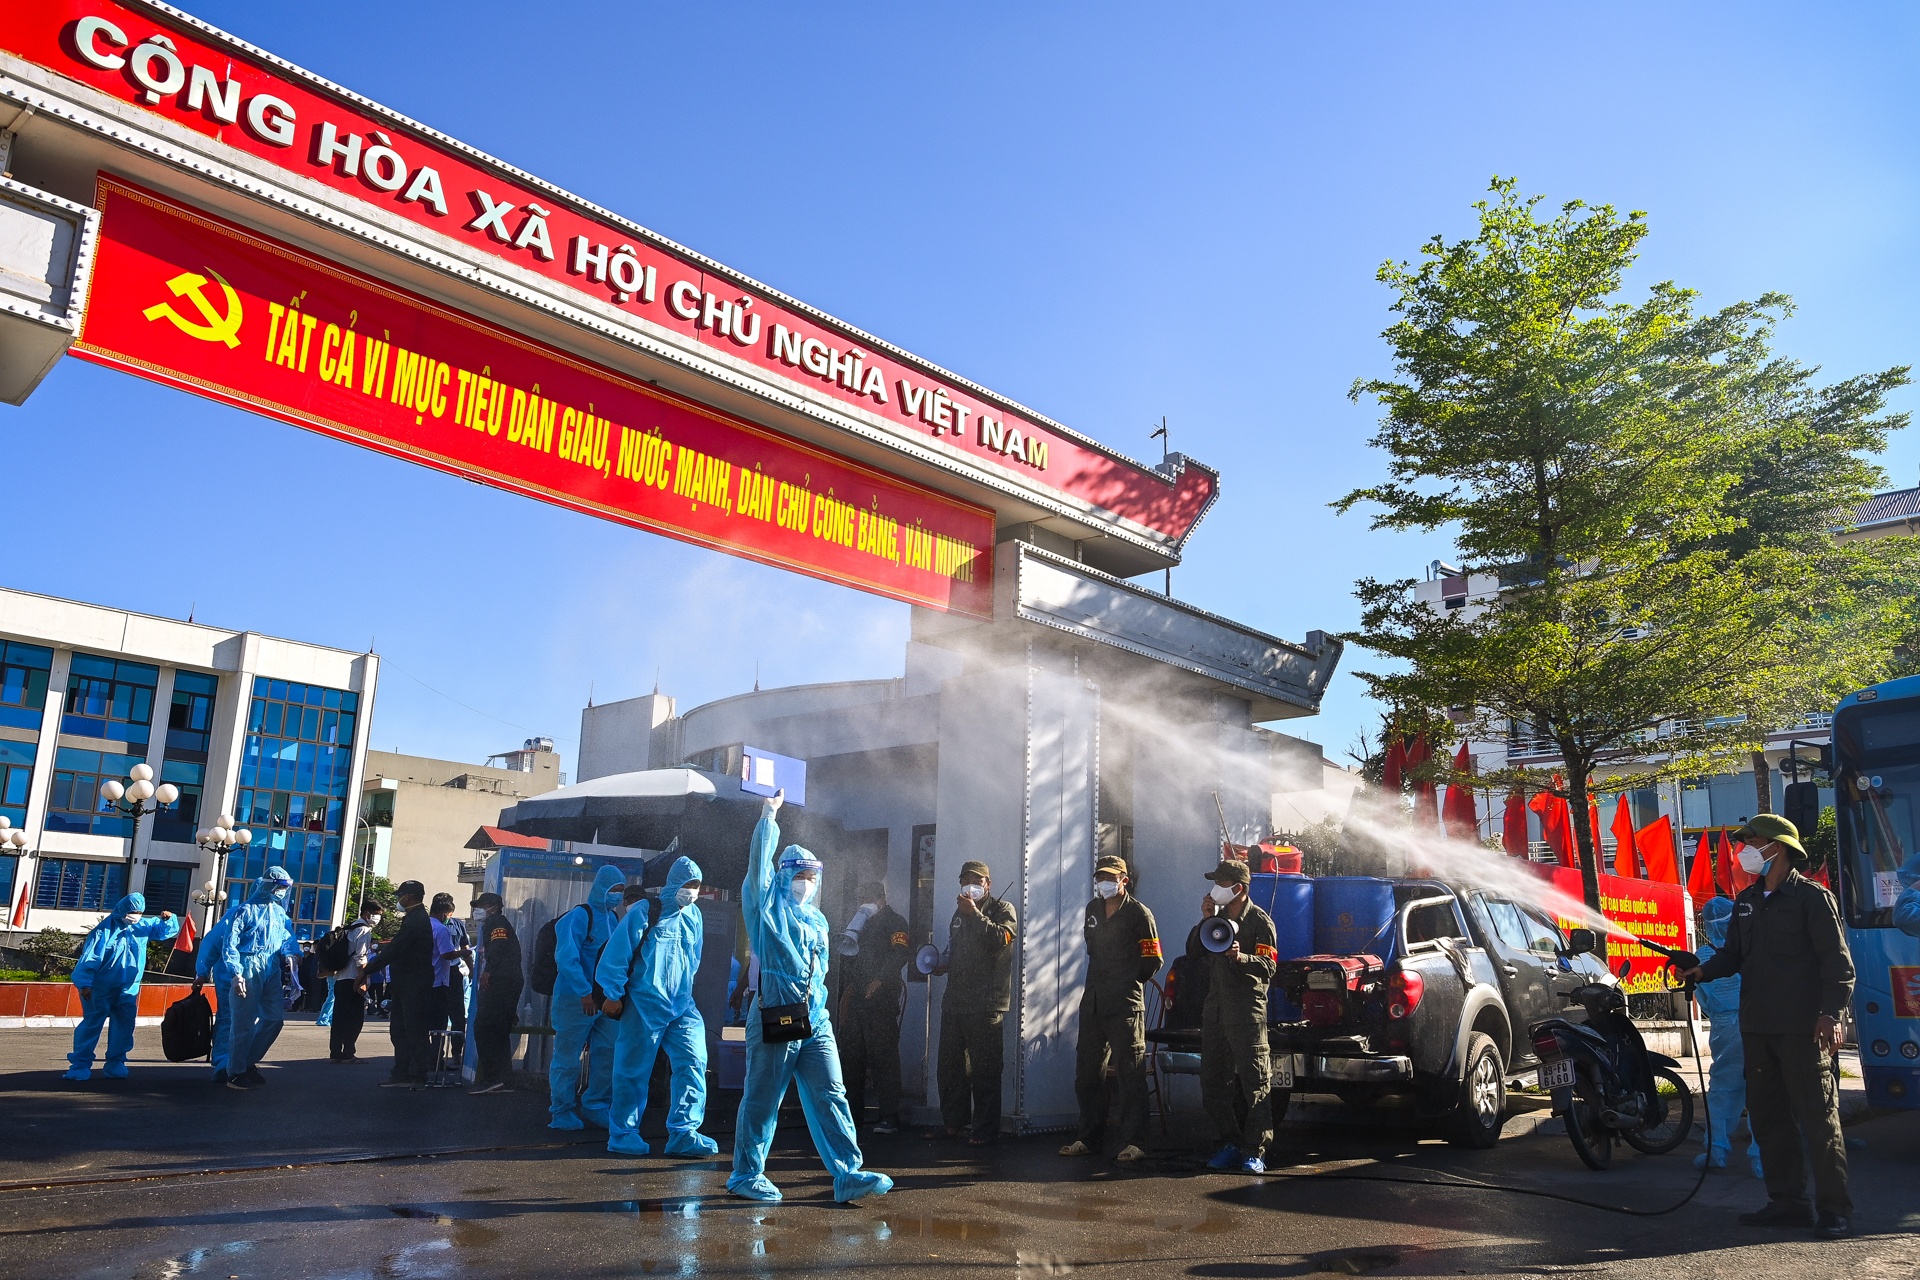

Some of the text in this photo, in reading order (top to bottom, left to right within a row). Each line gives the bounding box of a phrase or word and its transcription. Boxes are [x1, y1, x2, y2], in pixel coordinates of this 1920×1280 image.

[74, 15, 1049, 471] CỘNG HÒA XÃ HỘI CHỦ NGHĨA VIỆT NAM
[265, 290, 976, 584] TẤT CẢ VÌ MỤC TIÊU DÂN GIÀU, NƯỚC MẠNH, DÂN CHỦ CÔNG BẰNG, VĂN MINH!
[1544, 1072, 1569, 1087] 6460
